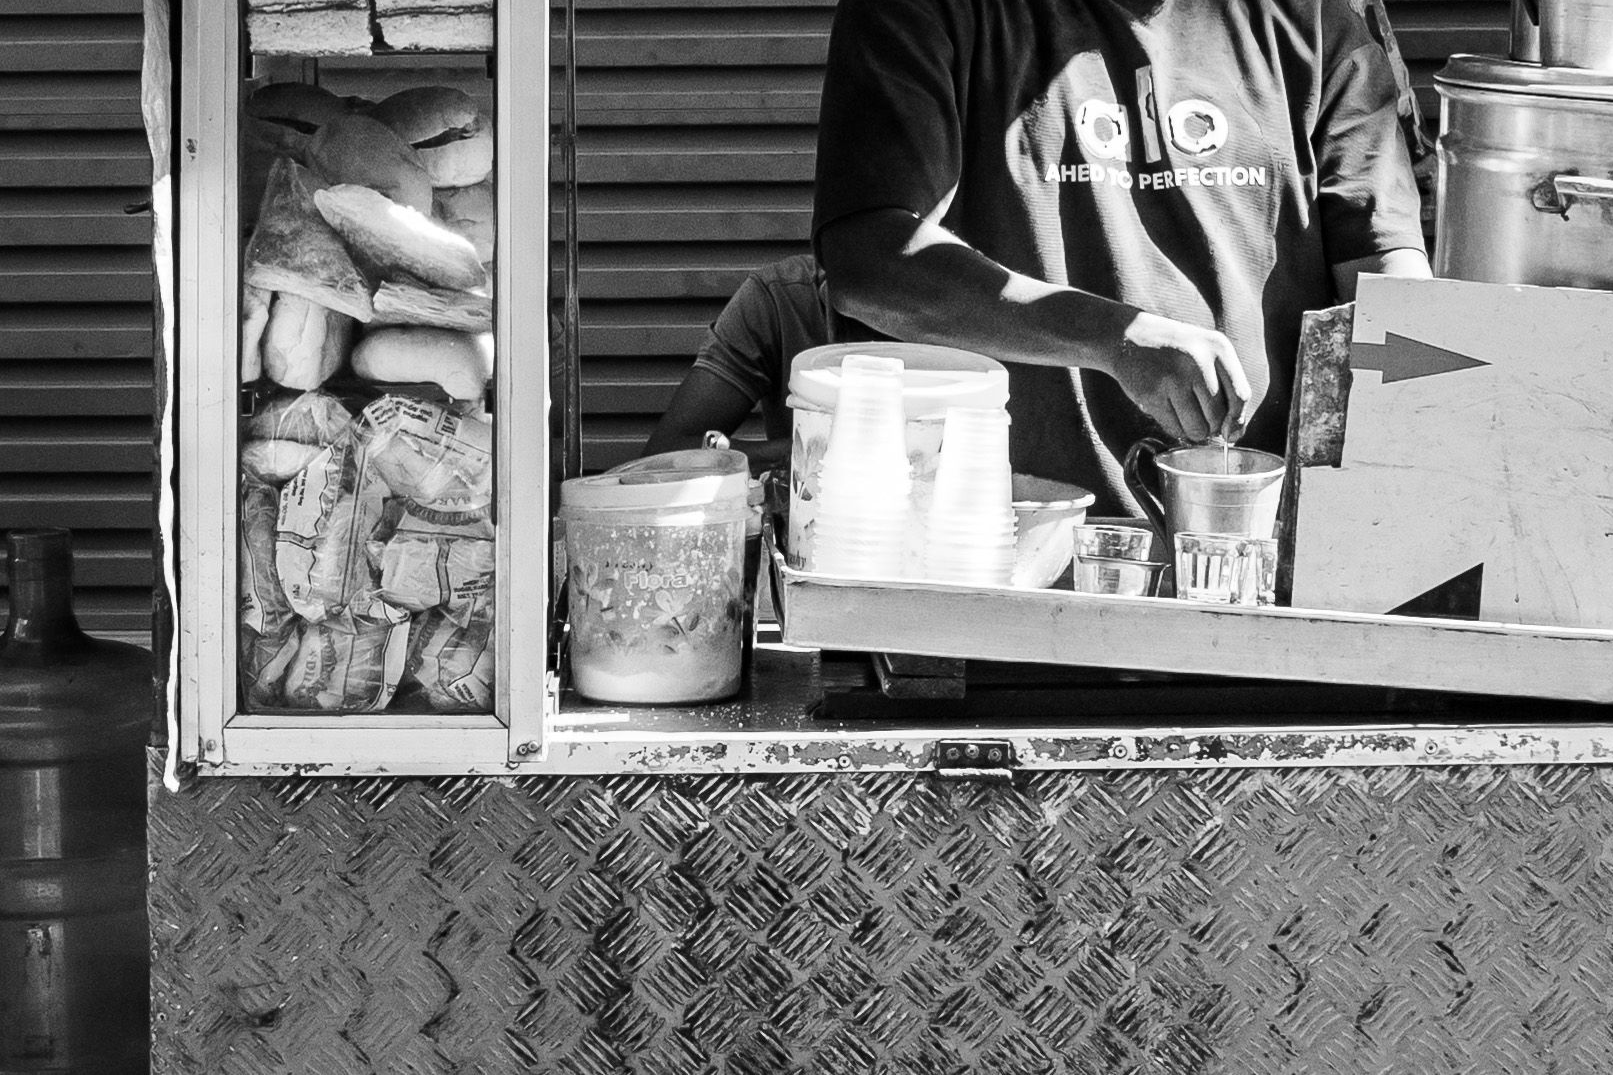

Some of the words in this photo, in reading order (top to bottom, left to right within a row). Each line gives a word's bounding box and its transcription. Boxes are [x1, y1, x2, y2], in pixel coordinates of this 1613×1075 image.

[1106, 167, 1133, 189] TO
[1139, 167, 1266, 190] PERFECTION
[624, 570, 689, 590] Flora
